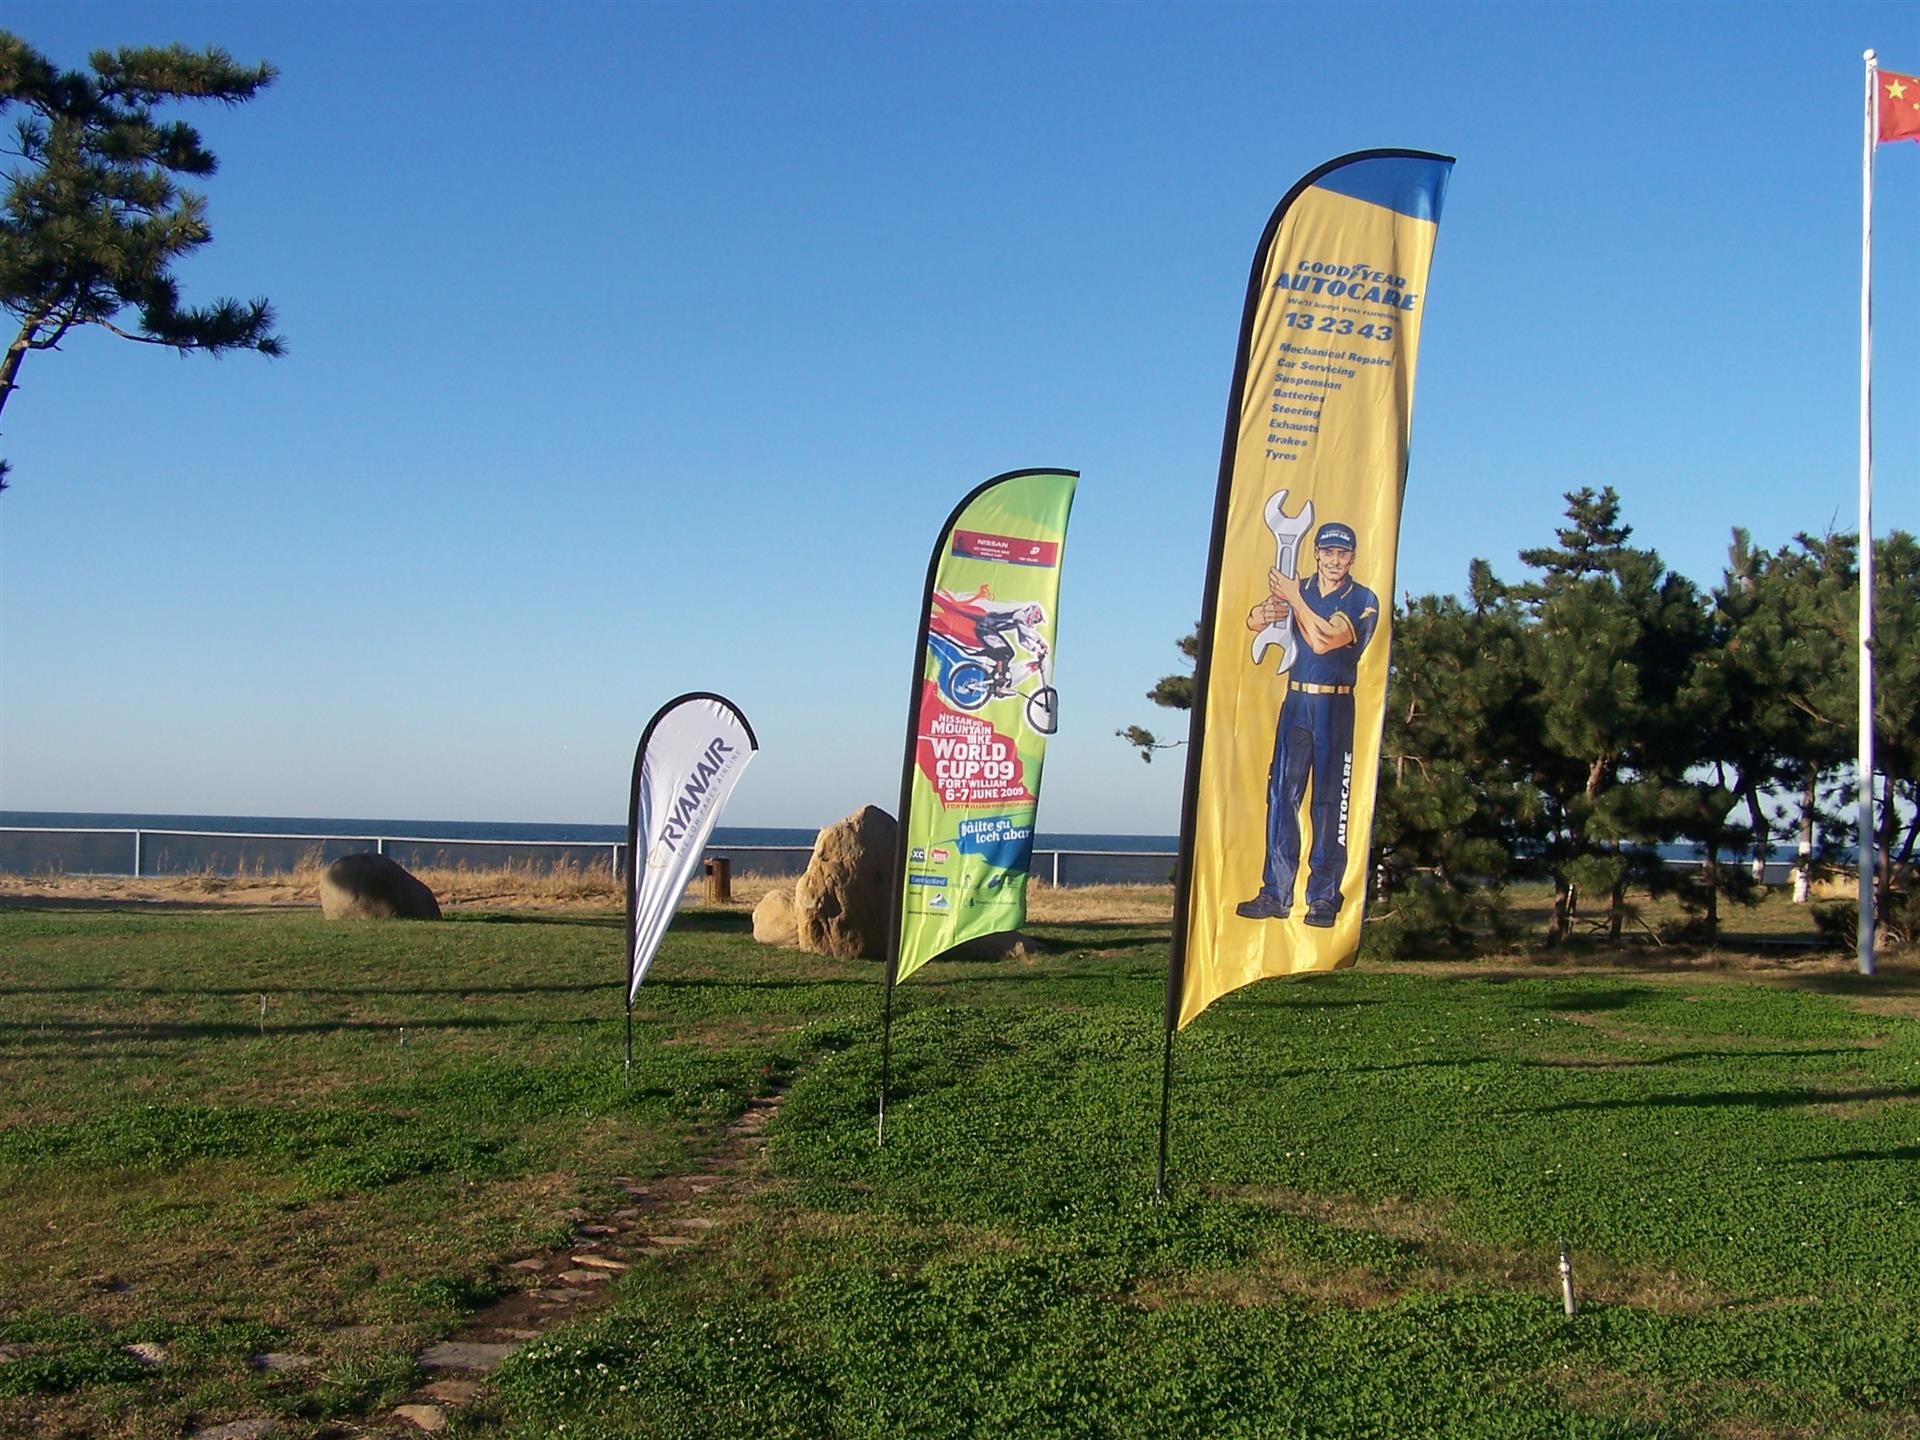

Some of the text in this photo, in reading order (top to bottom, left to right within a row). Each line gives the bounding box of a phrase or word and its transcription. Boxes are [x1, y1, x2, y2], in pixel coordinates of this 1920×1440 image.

[1298, 260, 1406, 289] GOODYEAR
[1272, 272, 1418, 311] AUTOCARE
[1342, 305, 1360, 314] you
[1286, 311, 1393, 341] 13 23 43
[1279, 342, 1393, 366] Mechanical Repairs
[1277, 357, 1356, 378] Car Servicing
[1274, 372, 1342, 390] Suspension
[1273, 388, 1325, 403] Batteries
[1271, 403, 1321, 419] Steering
[1269, 418, 1319, 433] Exhausts
[1267, 433, 1308, 447] Brakes
[1265, 448, 1298, 461] Tyres
[931, 720, 992, 735] MOUNTAIN
[939, 713, 972, 727] NISSAN
[967, 735, 993, 745] BIKE
[931, 738, 1007, 761] WORLD
[938, 778, 1007, 789] FORT WILLIAM
[659, 737, 734, 852] RYANAIR
[945, 787, 1024, 801] 6-7 JUNE 2009
[1338, 752, 1352, 847] AUTOCARE
[976, 831, 1000, 844] loch
